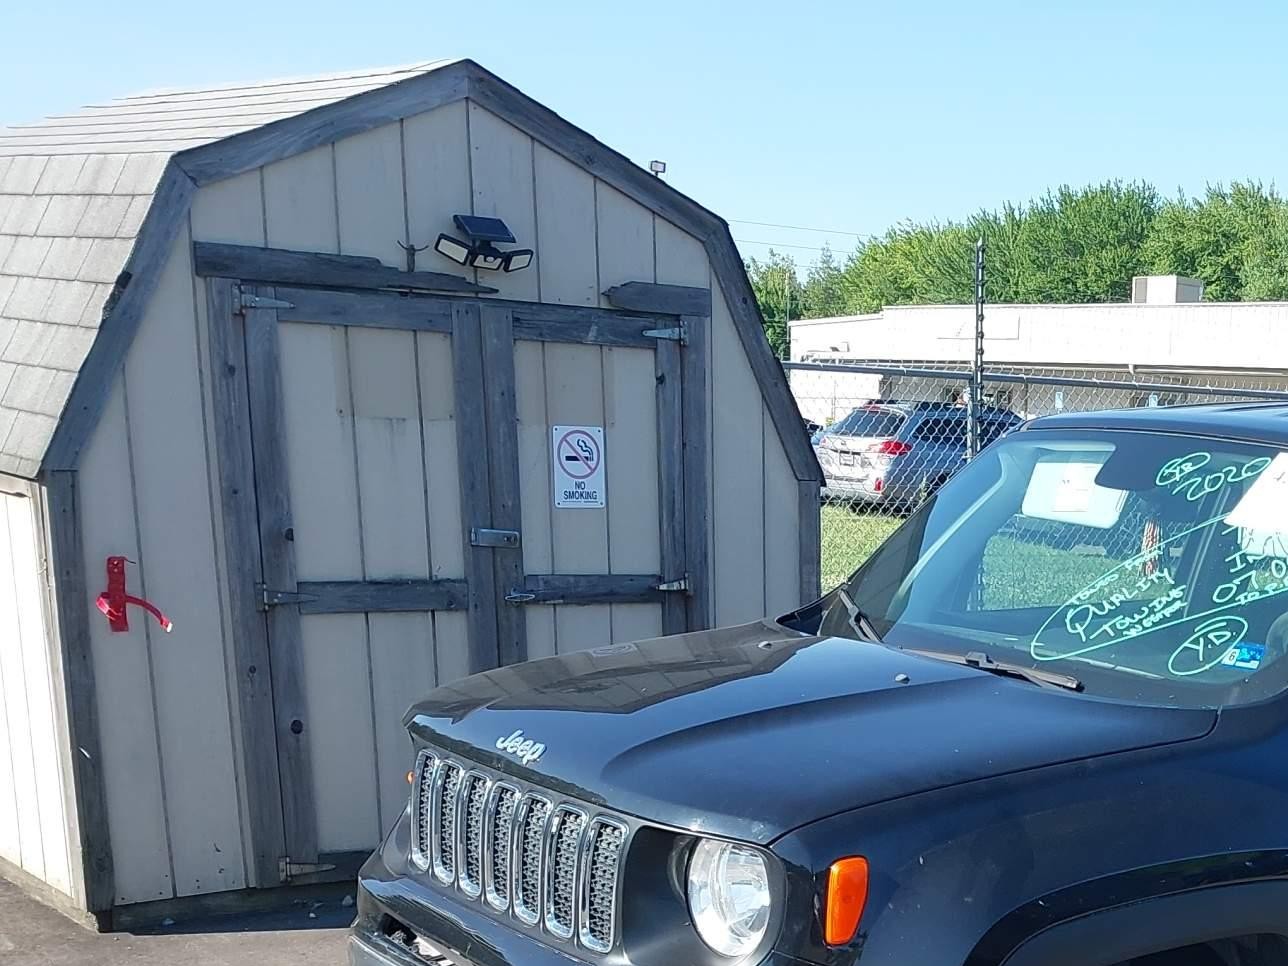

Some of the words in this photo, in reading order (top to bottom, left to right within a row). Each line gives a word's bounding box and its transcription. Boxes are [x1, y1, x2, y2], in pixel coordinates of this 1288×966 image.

[563, 490, 598, 500] SMOKING
[574, 481, 586, 490] NO
[1172, 458, 1271, 500] 2020
[1066, 568, 1175, 642] QUALITY
[1090, 585, 1187, 640] TOWING
[496, 730, 546, 765] Jeep
